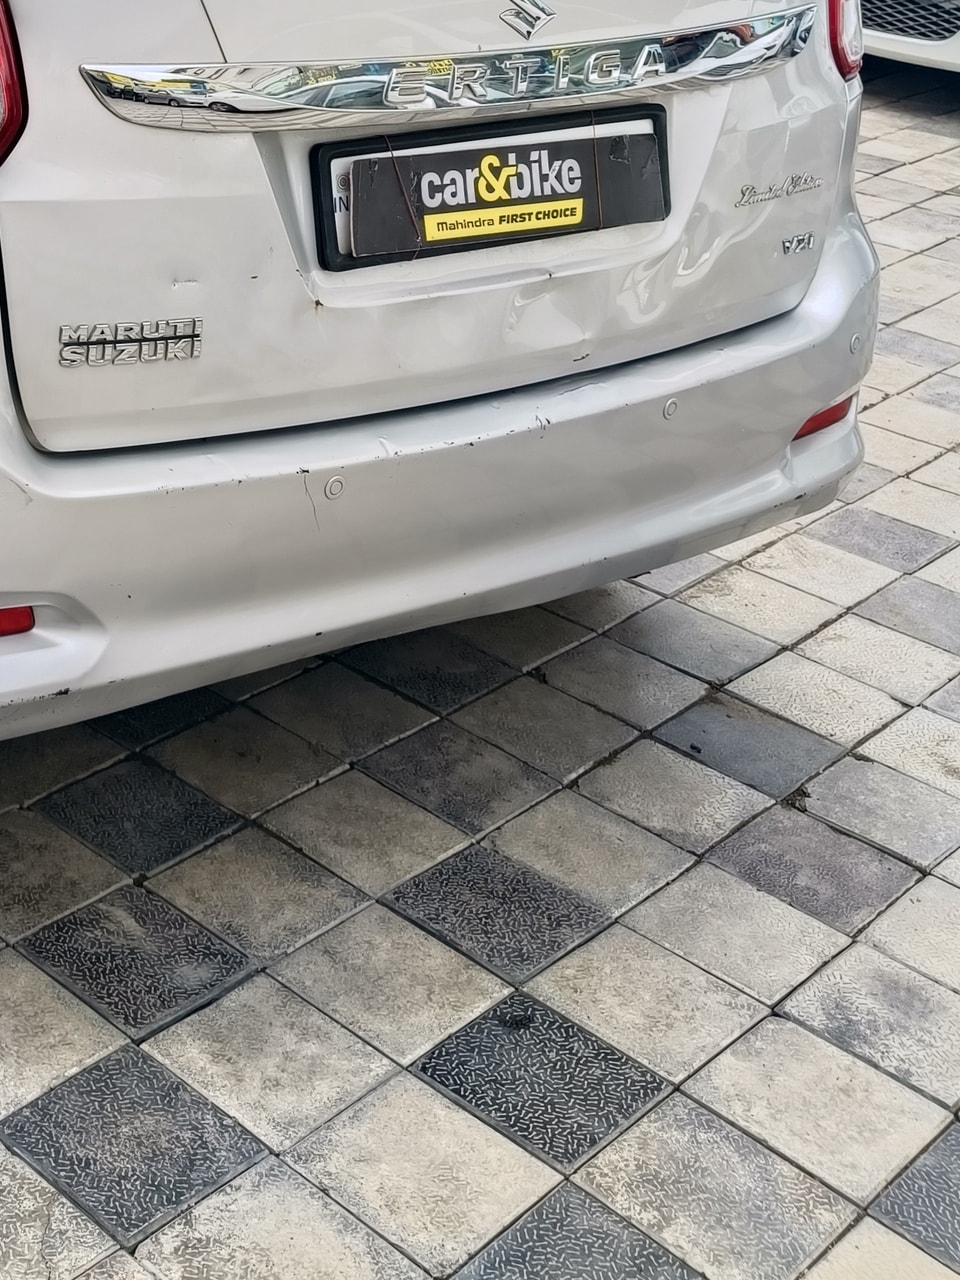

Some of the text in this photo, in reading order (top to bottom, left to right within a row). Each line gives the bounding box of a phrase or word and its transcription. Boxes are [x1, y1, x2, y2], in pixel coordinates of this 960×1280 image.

[382, 43, 667, 107] ERTIGA
[421, 150, 582, 208] car&bike
[437, 207, 577, 232] Mahindra FIRST CHOICE
[59, 317, 203, 344] MARUTI
[59, 337, 202, 368] SUZUKI
